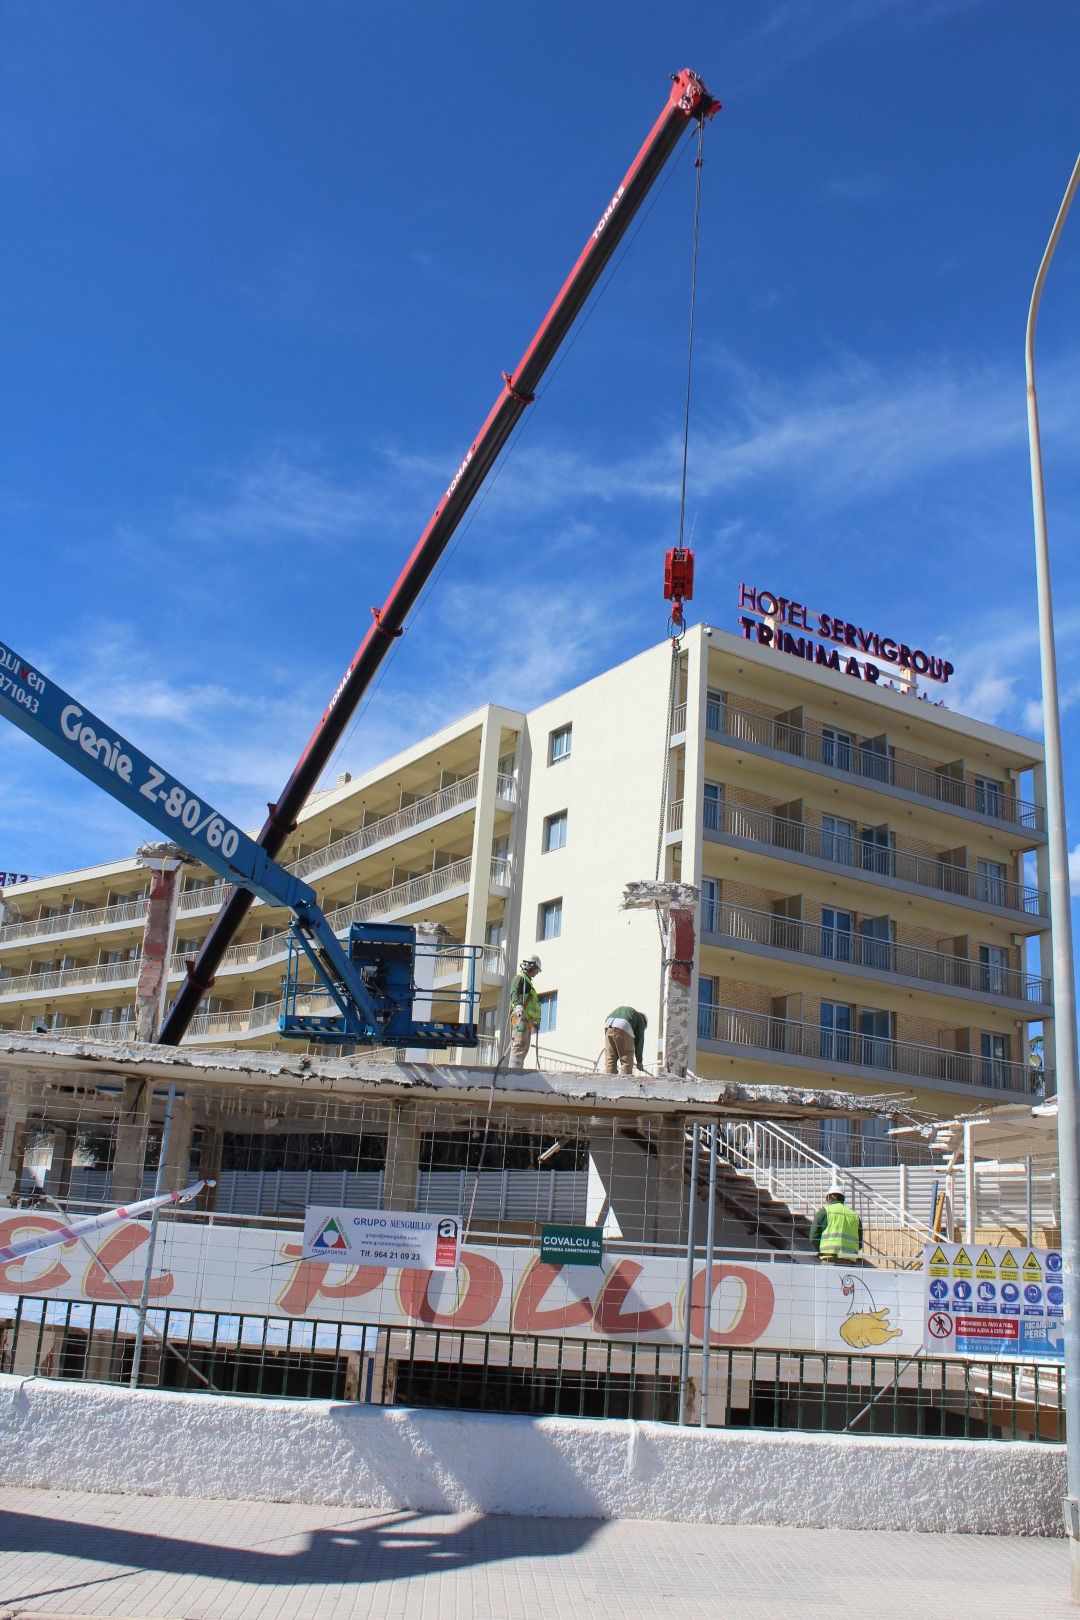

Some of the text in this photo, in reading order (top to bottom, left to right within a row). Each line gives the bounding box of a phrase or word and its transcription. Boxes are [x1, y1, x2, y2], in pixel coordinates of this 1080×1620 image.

[592, 184, 625, 239] TOMAS
[446, 449, 473, 498] TOMAS
[738, 582, 955, 684] HOTEL SERVIGROUP
[738, 615, 880, 685] TRINIMAR
[60, 703, 240, 858] Genie Z-80/60
[353, 1217, 387, 1228] GRUPO
[400, 1252, 410, 1260] 09
[411, 1253, 421, 1261] 23
[543, 1236, 601, 1248] COVALCU SL
[1024, 1321, 1053, 1330] RICARDO
[1024, 1328, 1047, 1339] PERIS
